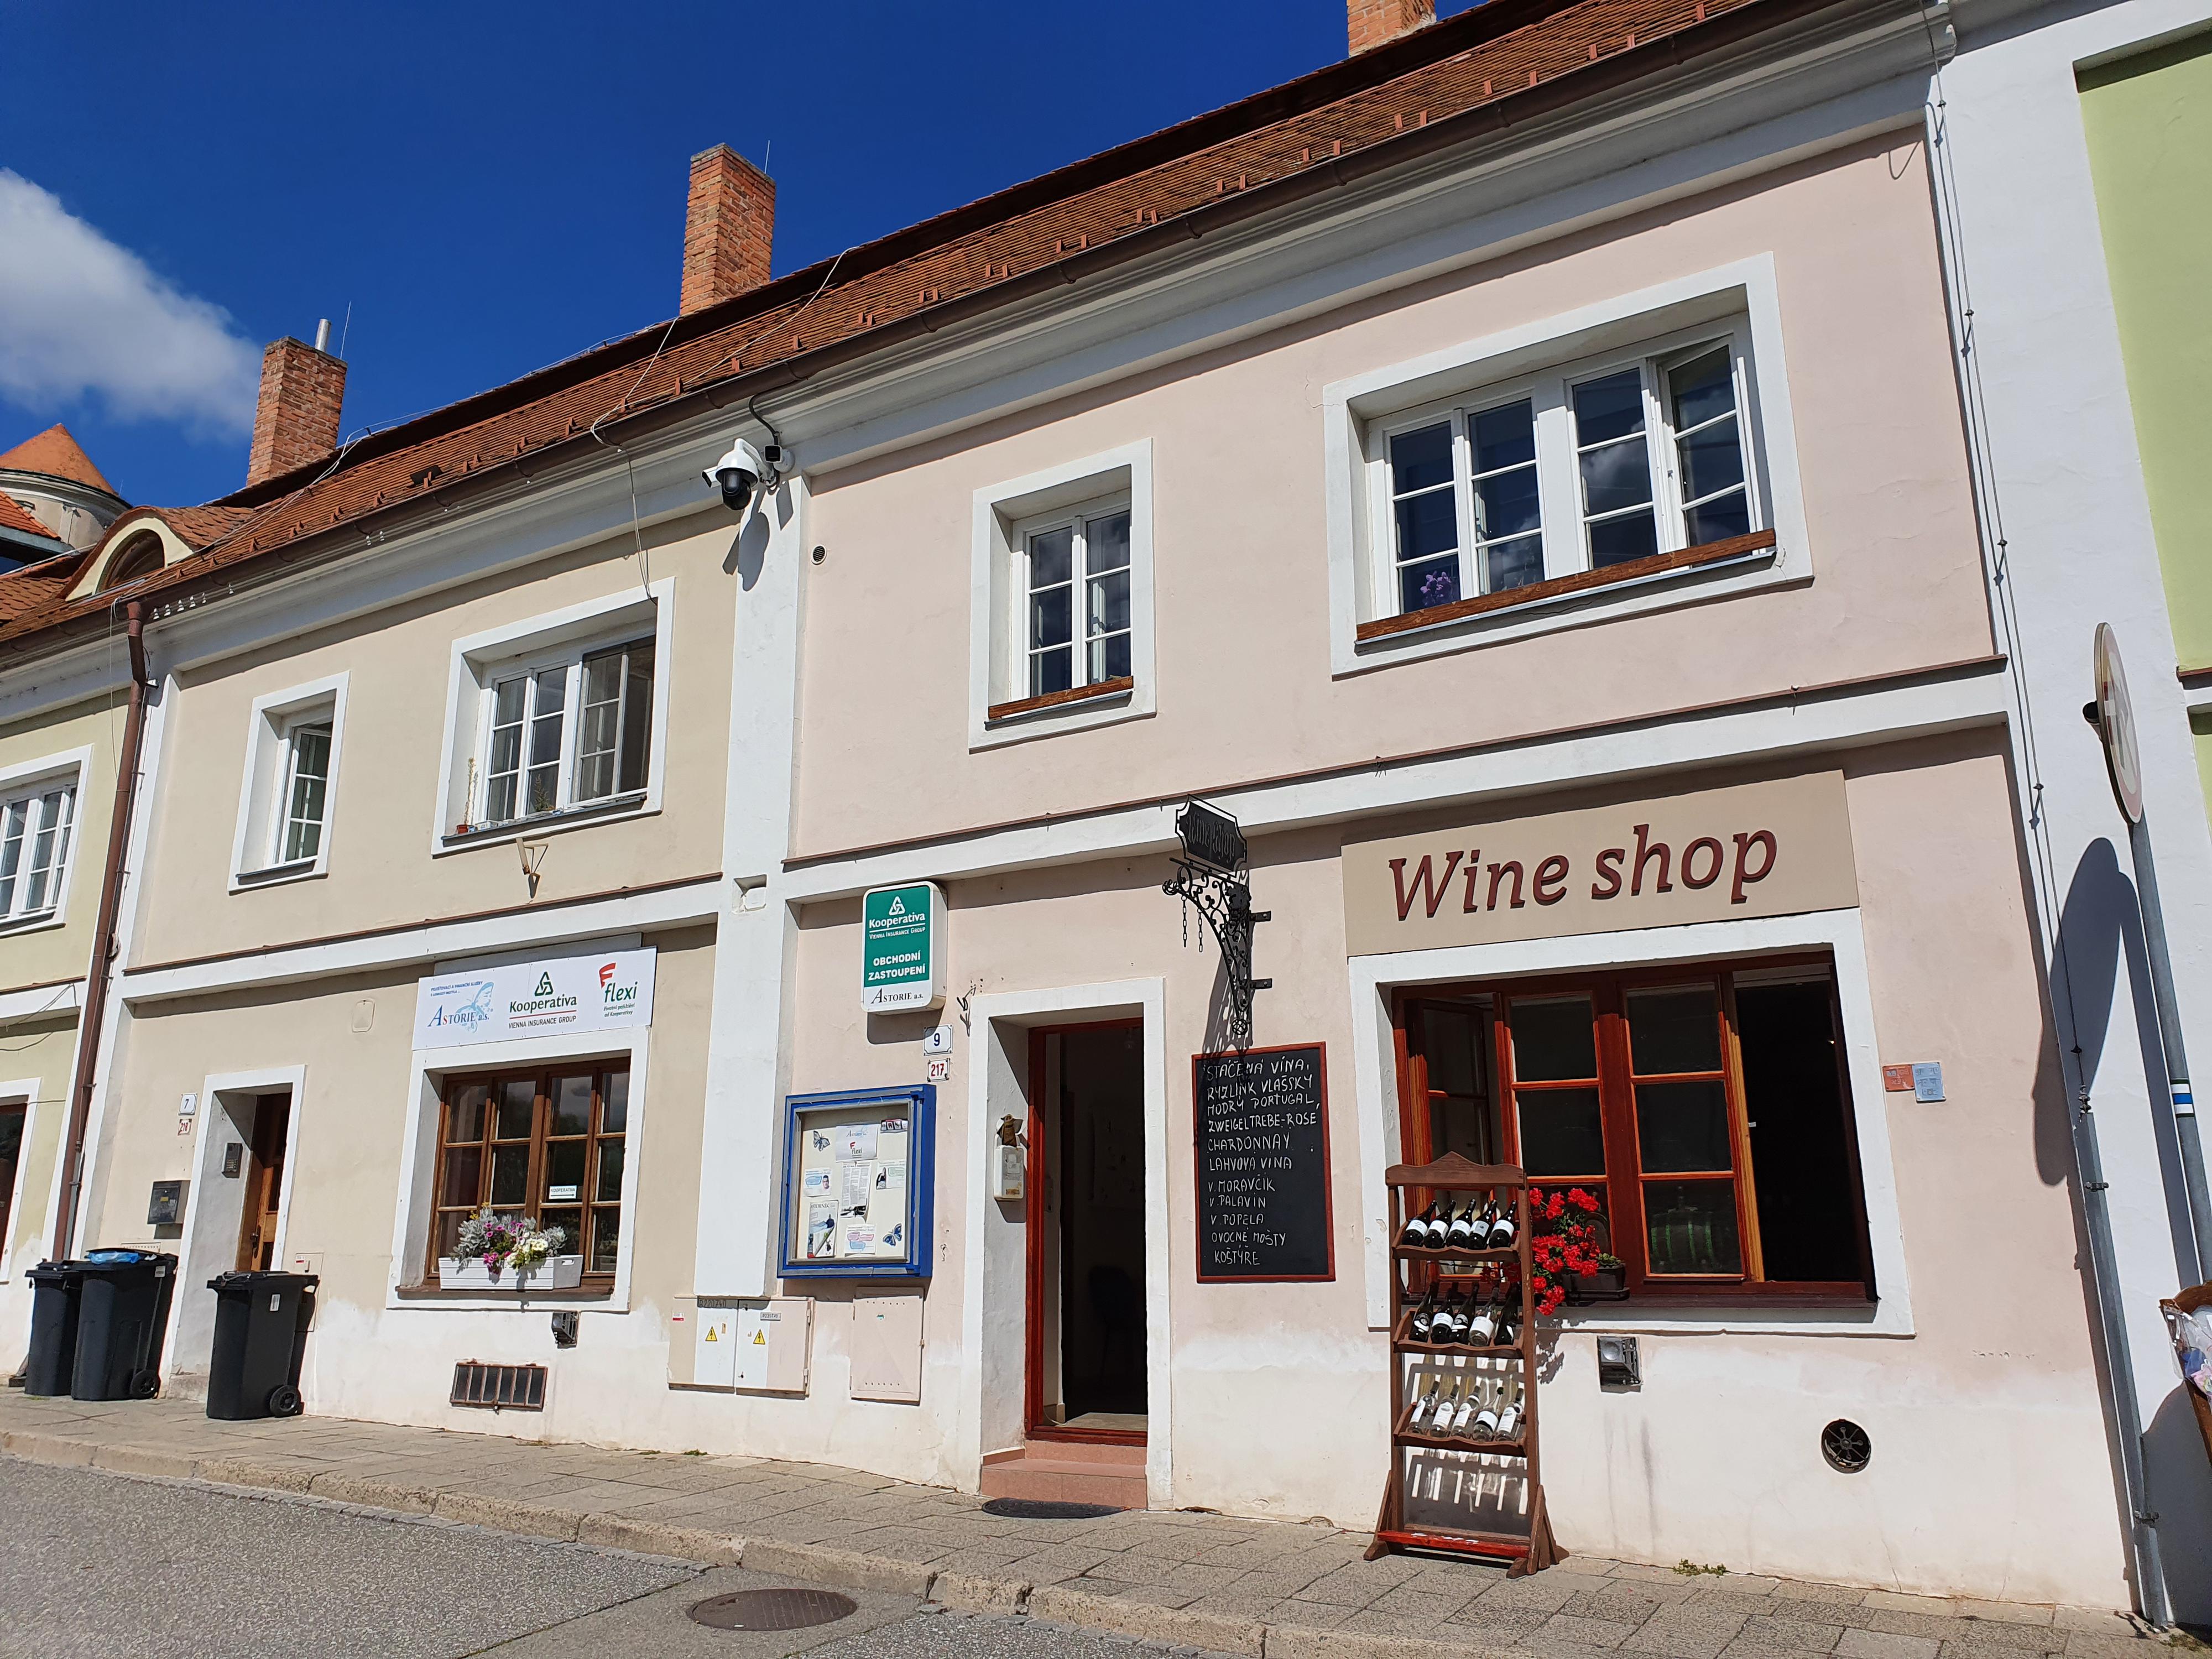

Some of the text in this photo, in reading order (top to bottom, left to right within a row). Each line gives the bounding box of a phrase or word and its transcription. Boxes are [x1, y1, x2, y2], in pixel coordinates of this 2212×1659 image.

[1389, 823, 1777, 920] Wine shop
[869, 912, 926, 928] Kooperativa
[886, 929, 910, 937] INSURANCE
[873, 950, 921, 967] OBCHODNÍ
[868, 963, 926, 981] ZASTOUPENÍ
[604, 981, 638, 1003] flexi
[870, 987, 912, 1004] ASTORIE
[509, 993, 577, 1014] Kooperativa
[427, 1004, 489, 1027] ASTORIE a.s.
[509, 1021, 526, 1029] VIENNA
[528, 1018, 557, 1026] INSURANCE
[933, 1032, 941, 1047] 9
[931, 1063, 945, 1077] 217
[1207, 1082, 1257, 1102] RYZLINK
[184, 1098, 189, 1109] 7
[1207, 1131, 1290, 1152] CHARDONNAY
[1222, 1213, 1264, 1226] POPELA
[1253, 1229, 1286, 1247] MOŠTY
[1214, 1244, 1261, 1266] KOŠTÝŘE
